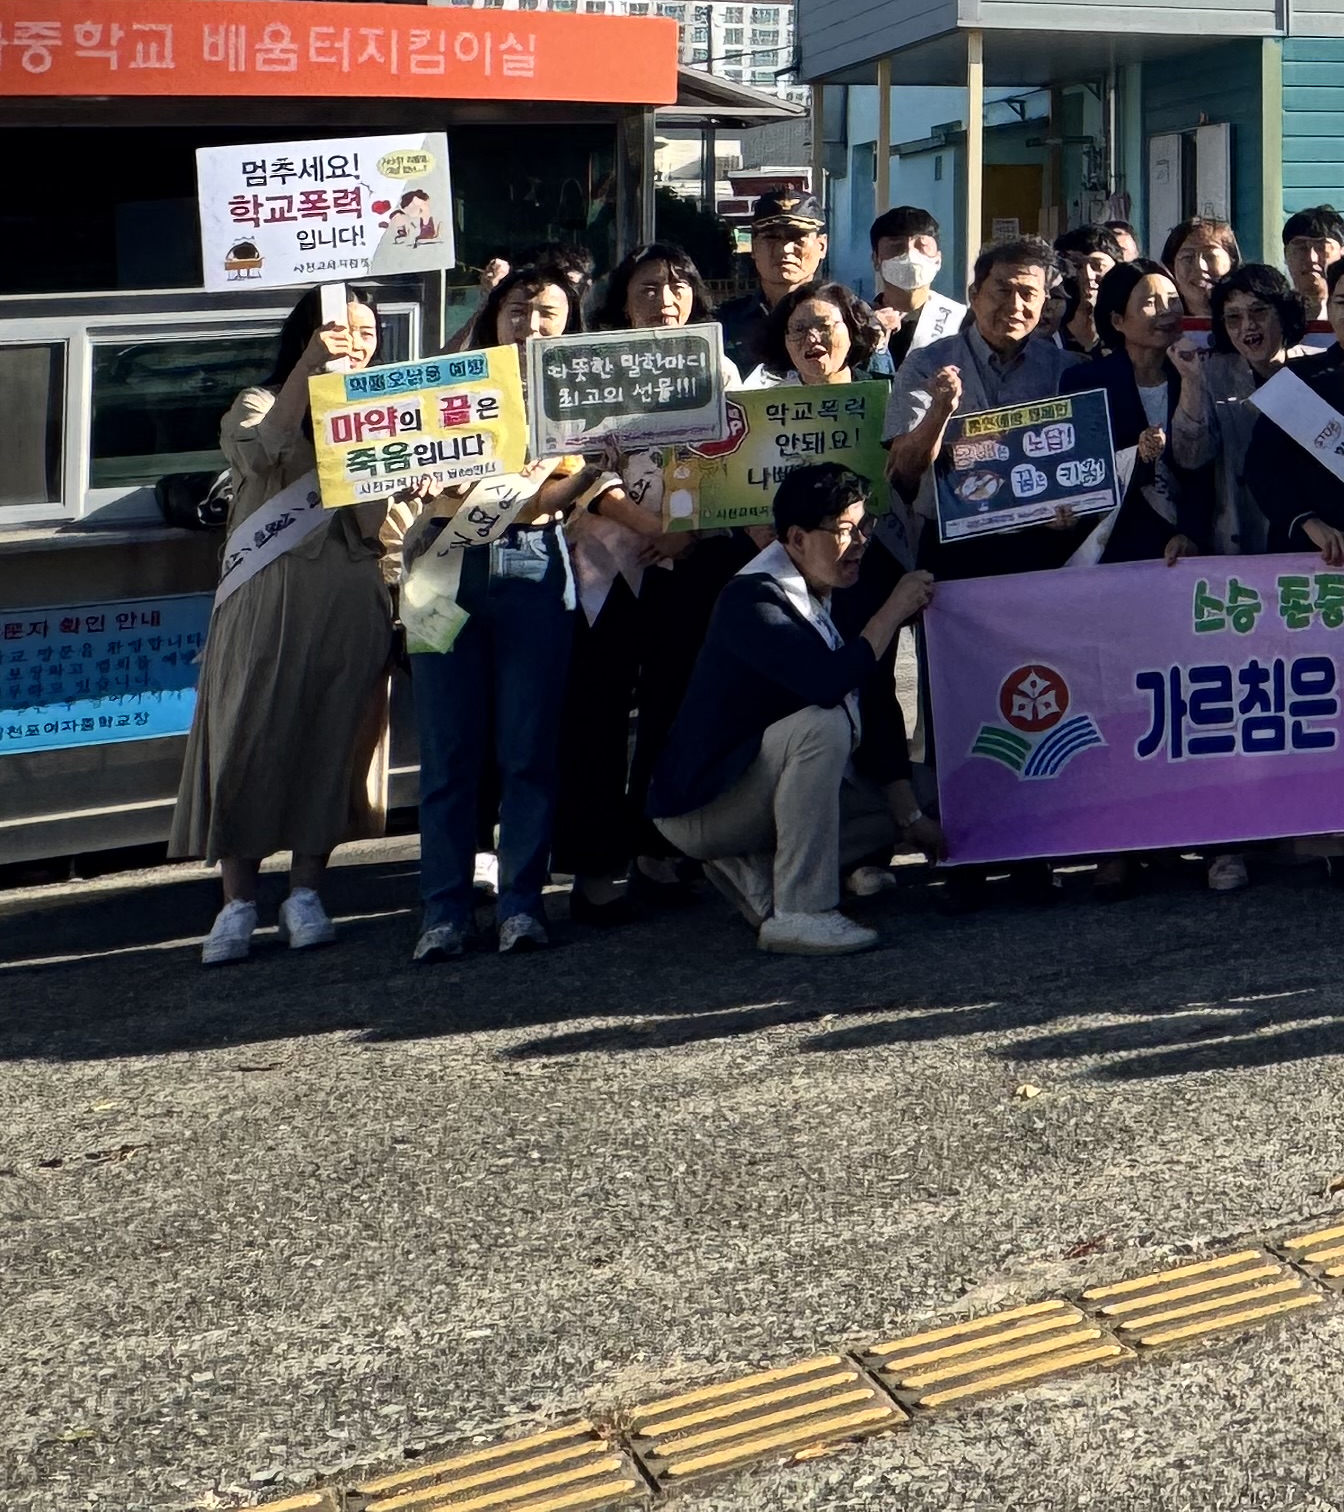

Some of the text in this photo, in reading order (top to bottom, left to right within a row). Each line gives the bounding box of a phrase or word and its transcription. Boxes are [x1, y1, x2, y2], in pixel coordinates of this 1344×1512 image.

[0, 20, 537, 78] 중학교 배움터지킴이실
[242, 153, 361, 187] 멈추세요!
[228, 187, 364, 228] 학교폭력
[296, 225, 366, 251] 입니다!
[620, 352, 706, 378] 말한마디
[331, 406, 422, 443] 마약의
[346, 433, 485, 476] 죽음입니다
[0, 619, 48, 640] 문자
[116, 610, 161, 631] 안내
[1194, 579, 1262, 634] 스승
[0, 711, 150, 739] 천포여자중학교장
[1135, 656, 1339, 760] 가르침은
